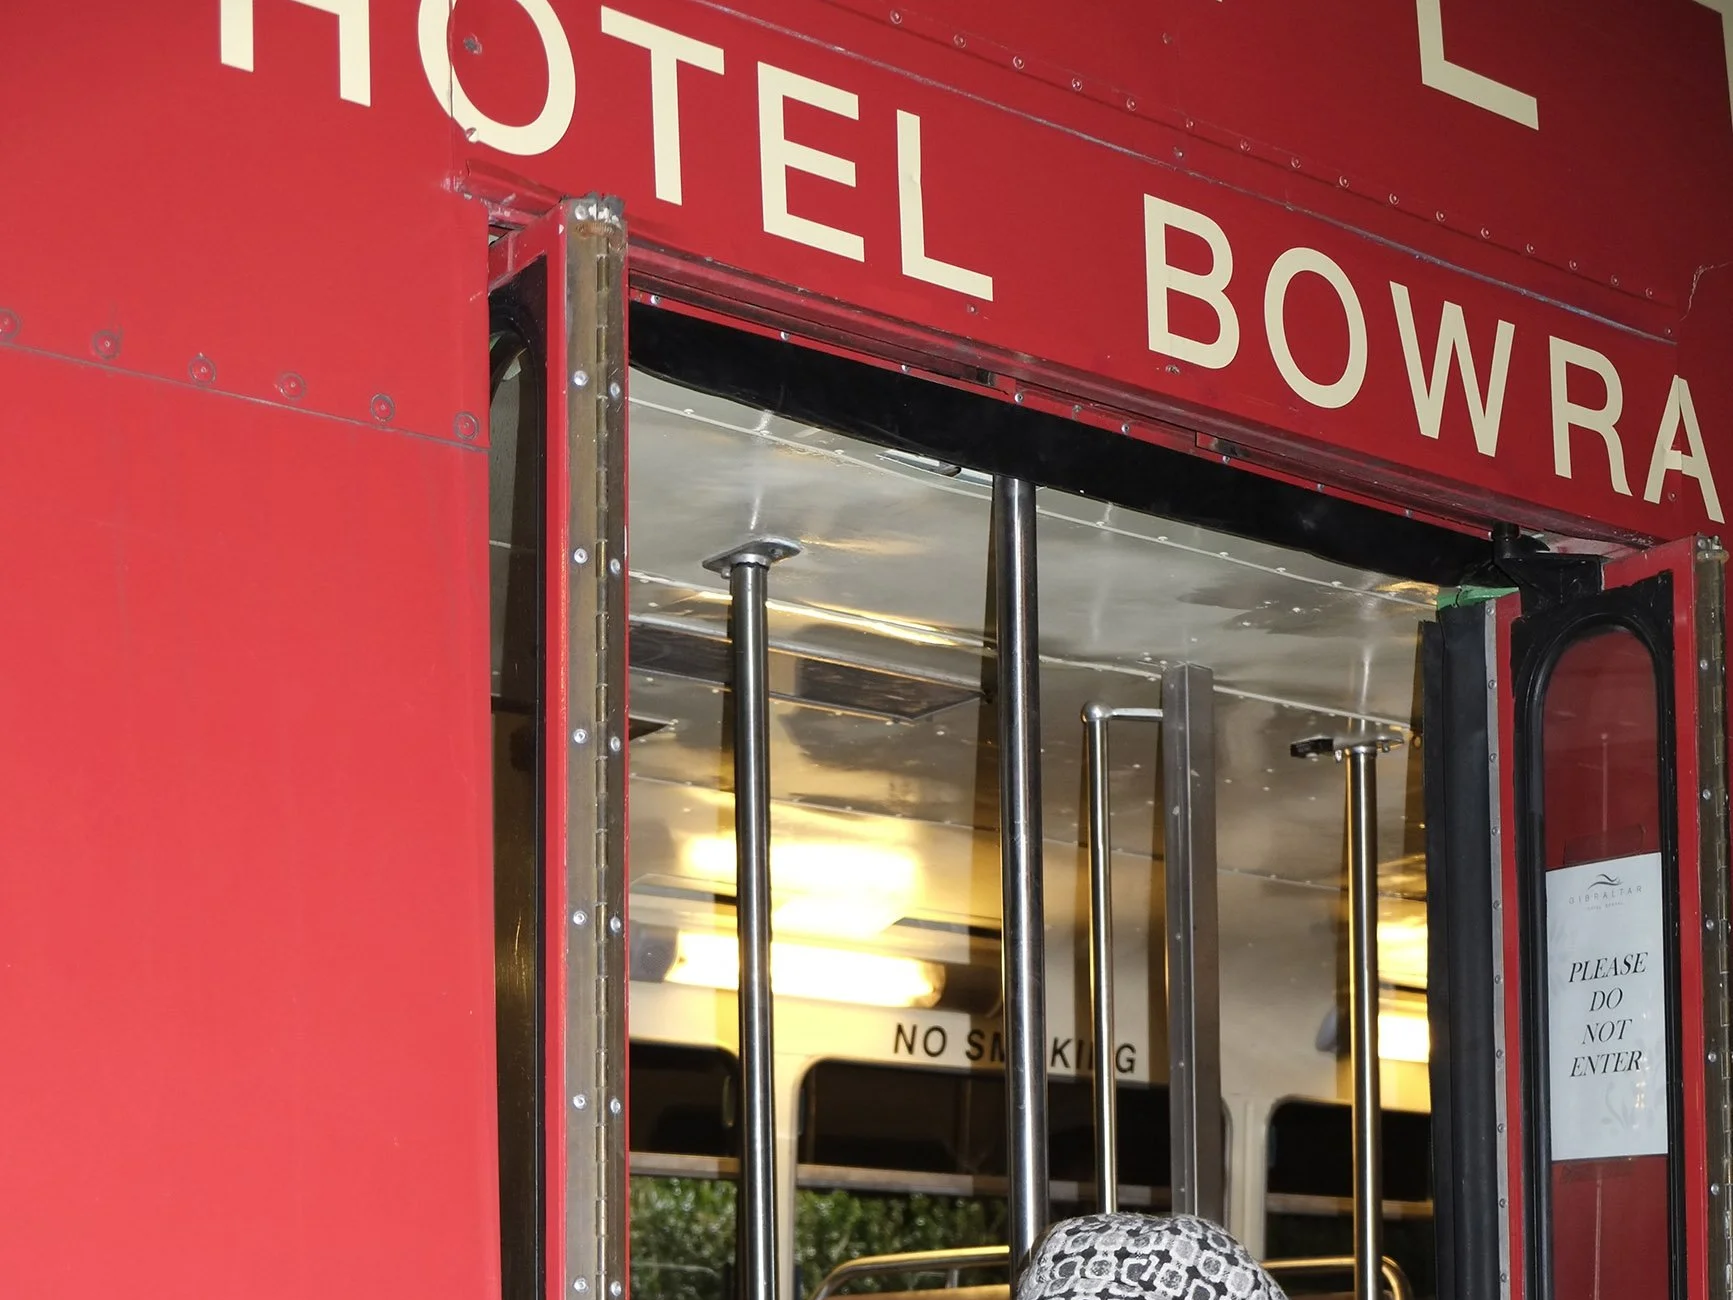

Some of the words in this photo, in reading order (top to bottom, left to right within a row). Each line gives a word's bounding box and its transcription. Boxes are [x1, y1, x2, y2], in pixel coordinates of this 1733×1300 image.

[1144, 193, 1725, 524] BOWRA
[1568, 952, 1648, 983] PLEASE
[1589, 987, 1623, 1012] DO
[1582, 1019, 1632, 1045] NOT
[894, 1023, 947, 1057] NO
[965, 1029, 1136, 1073] SKIG
[1569, 1050, 1642, 1077] ENTER
